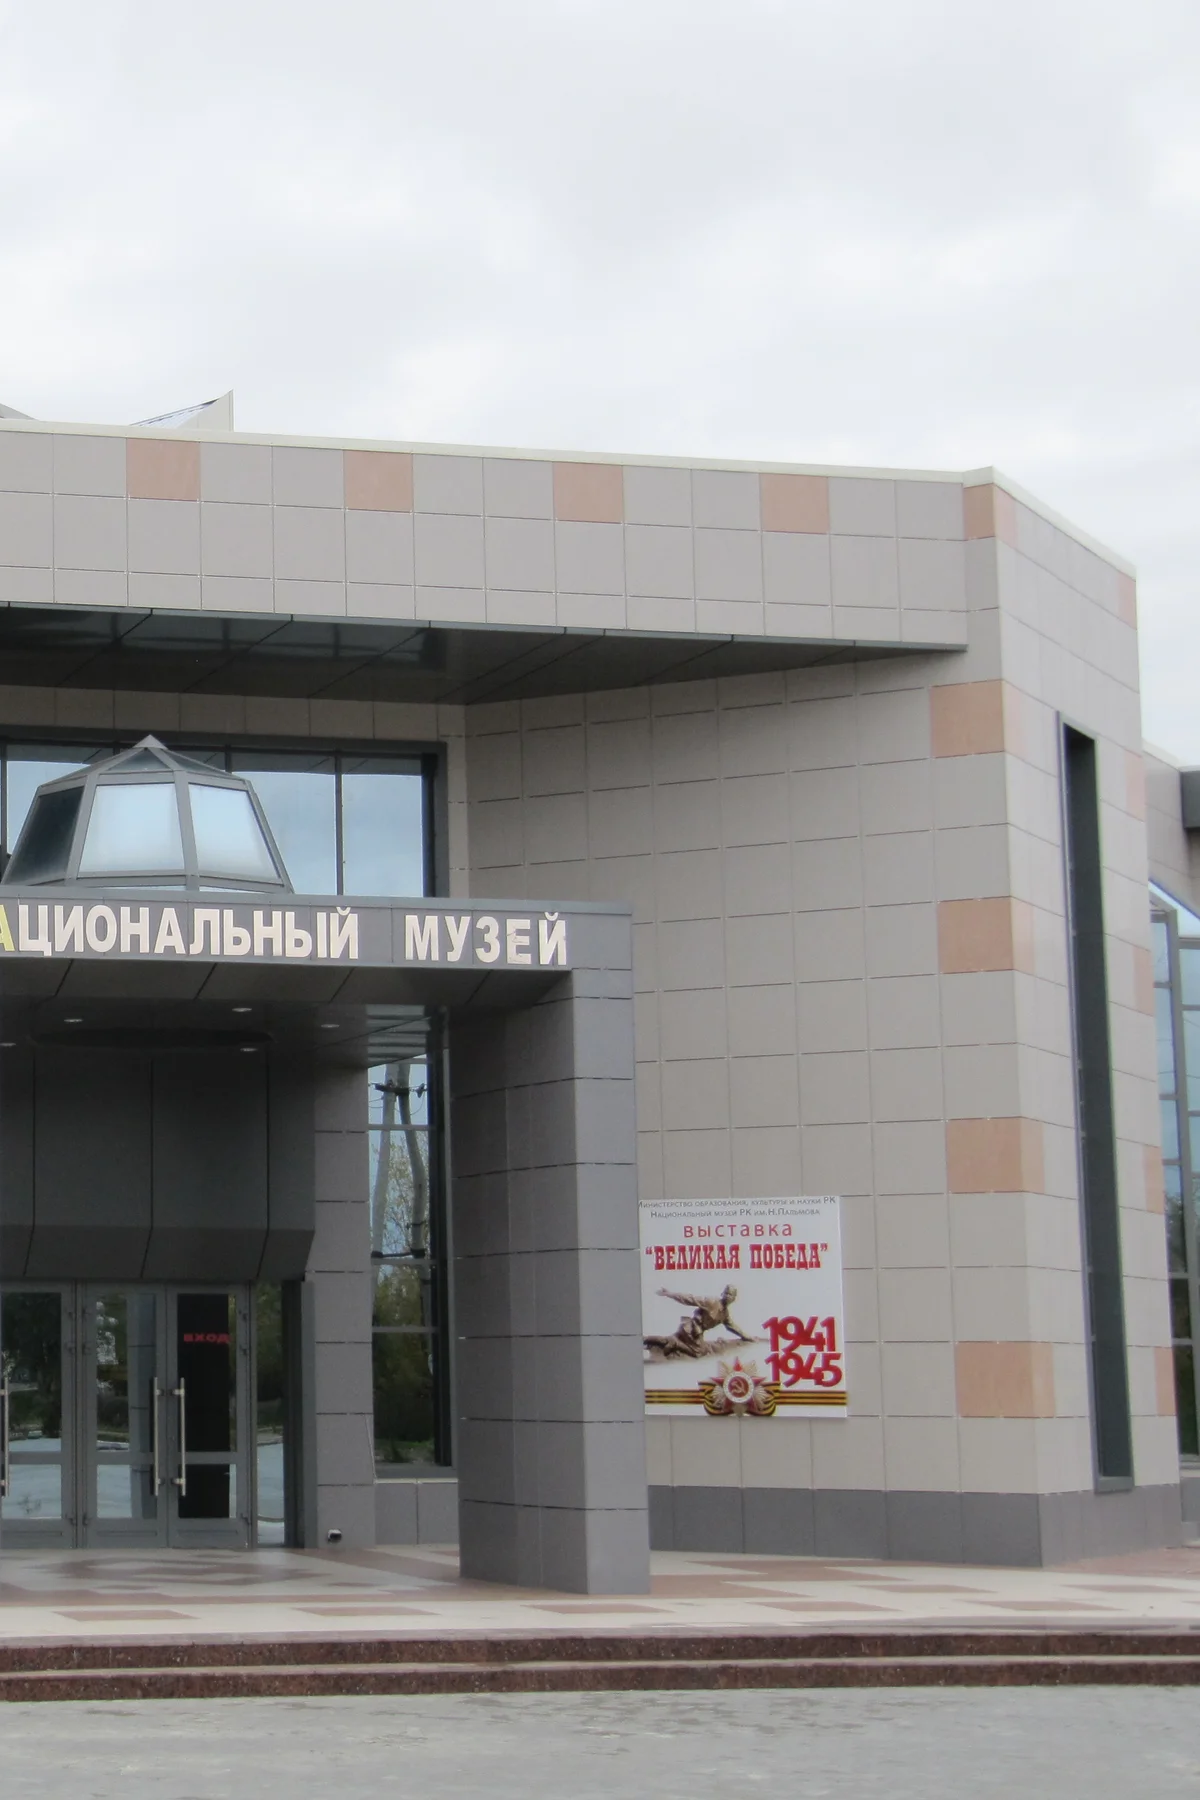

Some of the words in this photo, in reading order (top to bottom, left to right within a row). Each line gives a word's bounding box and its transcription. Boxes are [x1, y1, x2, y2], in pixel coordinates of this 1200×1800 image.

[405, 911, 568, 966] МУЗЕЙ
[823, 1196, 836, 1204] РК
[762, 1316, 836, 1352] 1941
[765, 1352, 842, 1387] 1945
